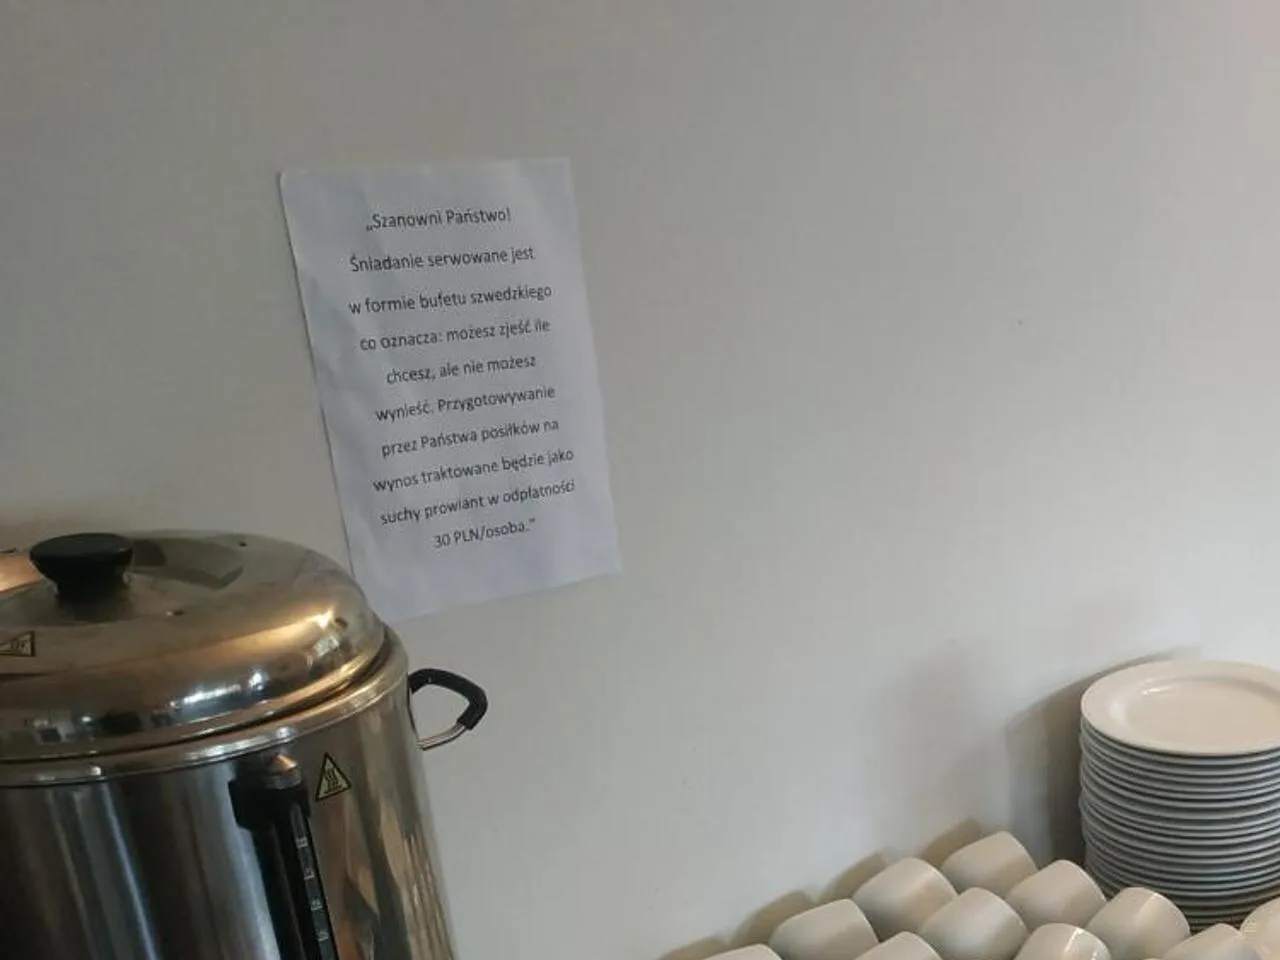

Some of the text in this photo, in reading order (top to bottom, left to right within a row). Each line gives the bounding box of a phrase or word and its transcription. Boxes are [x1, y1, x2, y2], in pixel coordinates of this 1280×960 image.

[446, 206, 512, 224] Państwo!
[350, 247, 536, 273] Śniadanie serwowane jest
[348, 285, 552, 315] w formie bufetu szwedzkiego
[359, 318, 551, 351] co oznacza: możesz zjeść ile
[386, 355, 537, 385] chcesz, ale nie możesz
[437, 386, 556, 413] Przygotowywanie
[381, 420, 560, 459] przez Państwa posiłków na
[372, 448, 574, 493] wynos traktowane będzie jako
[380, 507, 421, 526] suchy
[424, 495, 484, 519] prowiant
[488, 494, 501, 506] w
[434, 533, 451, 549] 30
